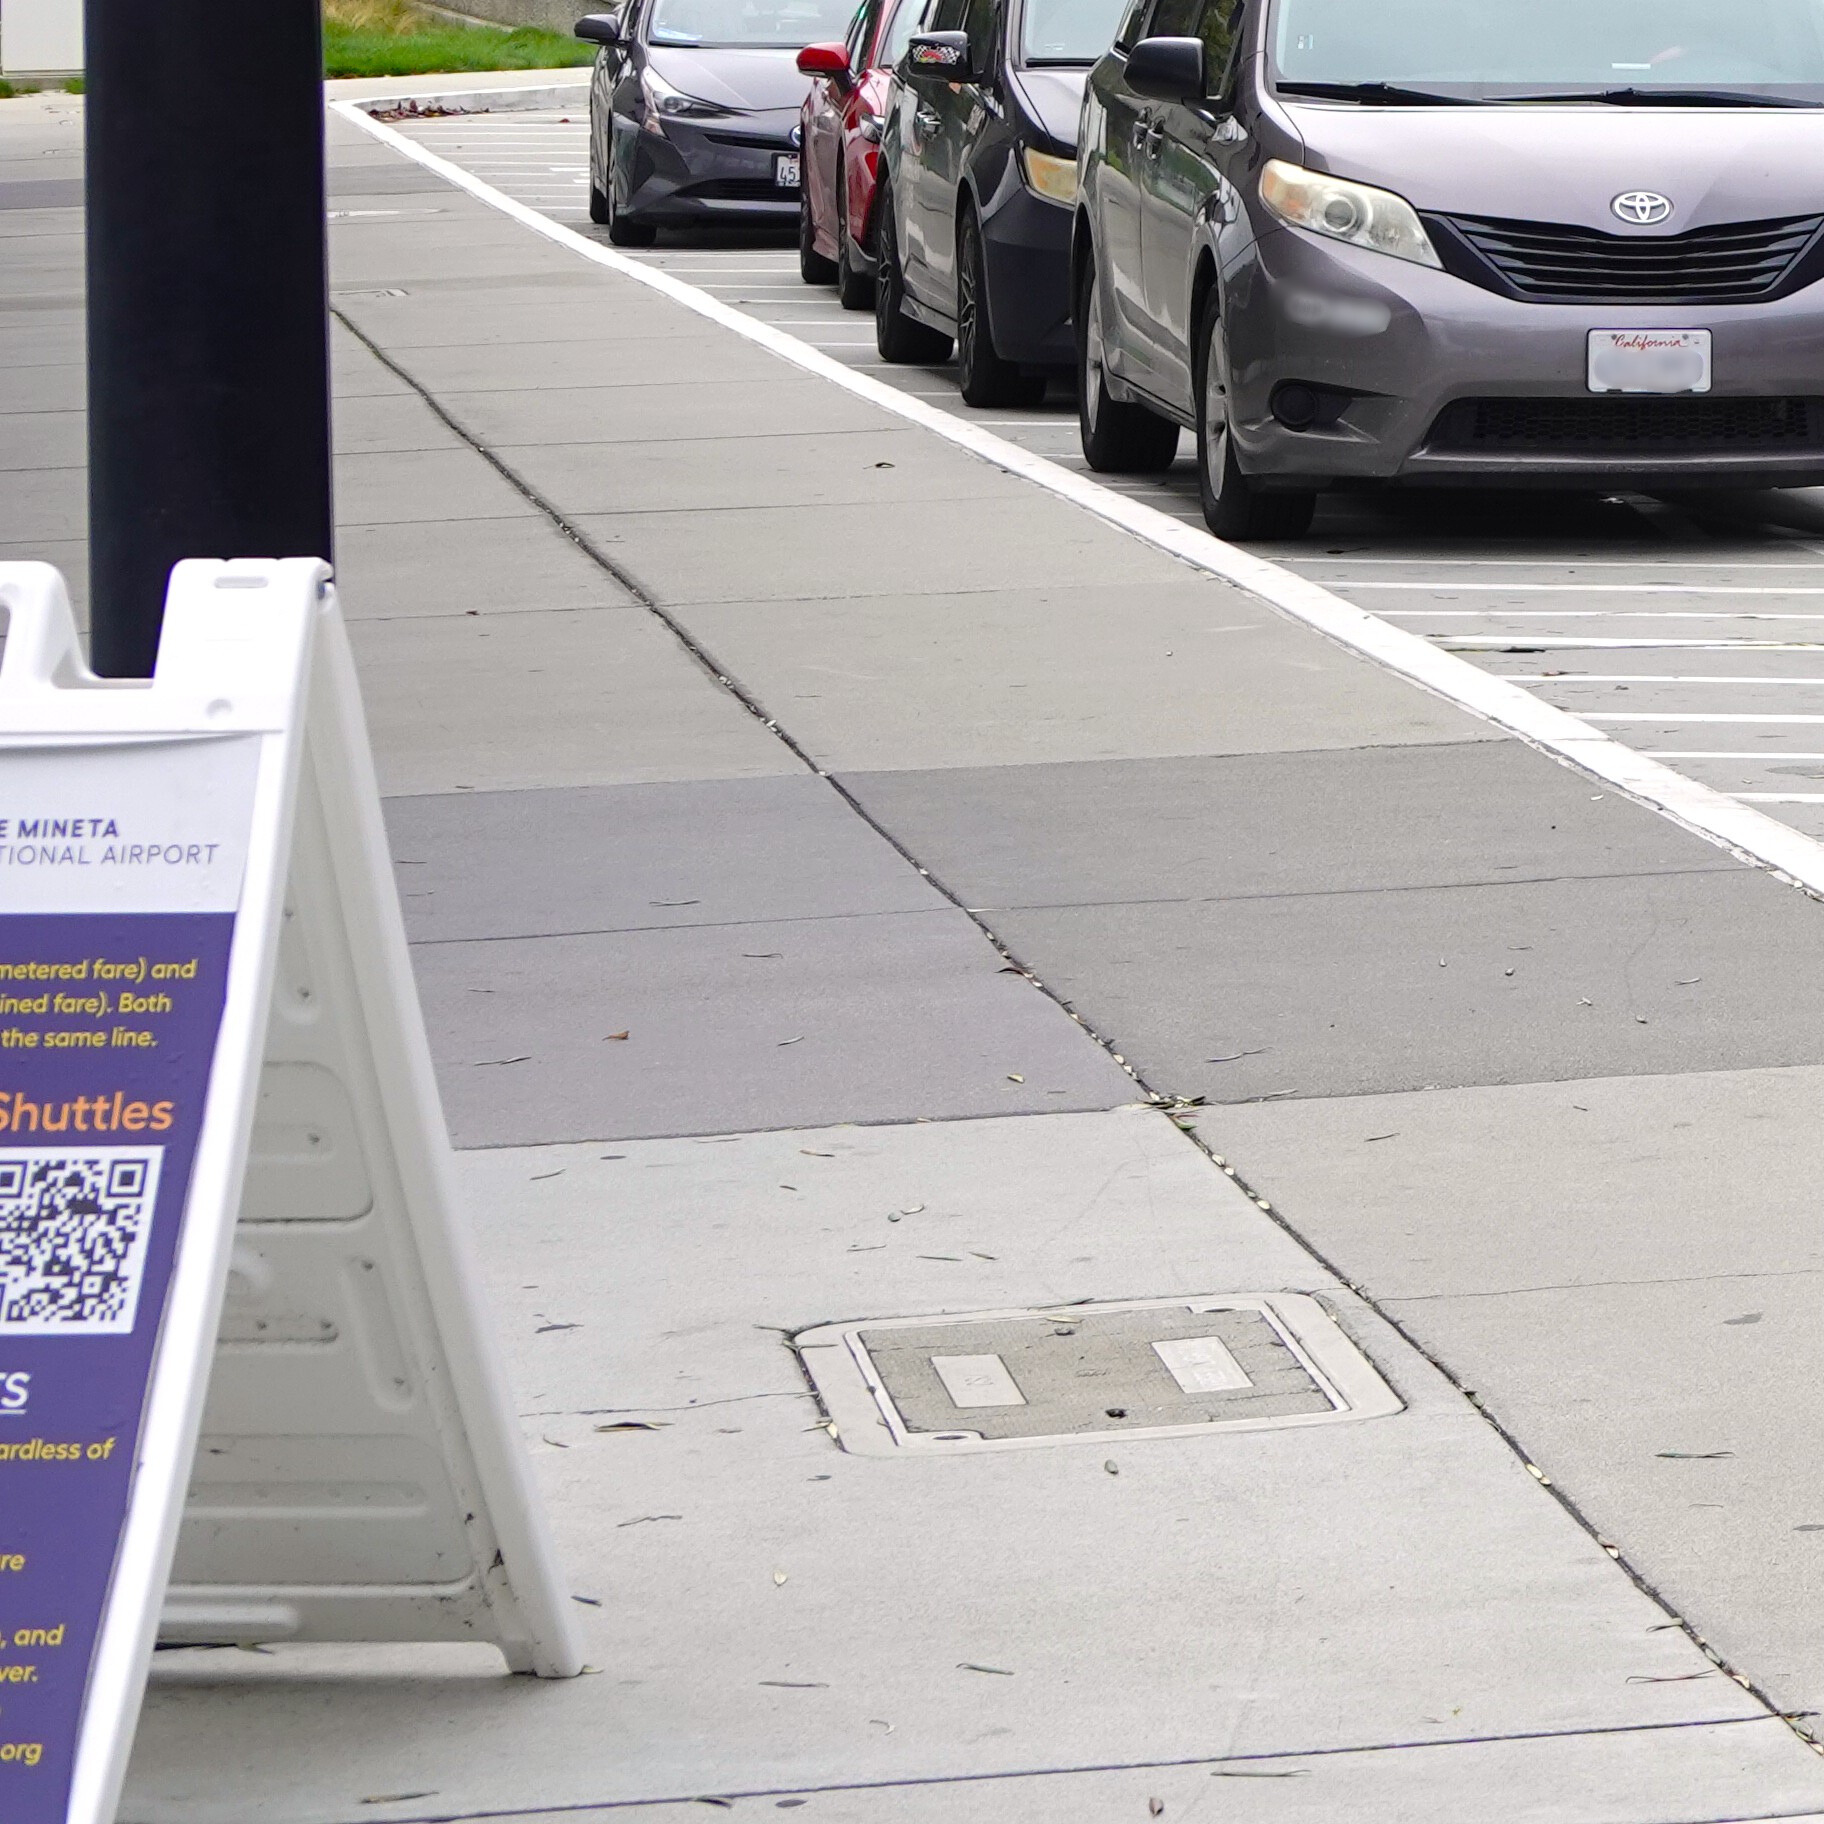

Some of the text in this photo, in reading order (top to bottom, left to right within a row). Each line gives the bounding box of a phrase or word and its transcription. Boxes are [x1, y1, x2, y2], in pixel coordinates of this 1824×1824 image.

[1615, 334, 1688, 350] California
[17, 819, 119, 838] MINETA
[101, 844, 219, 865] AIRPORT
[93, 957, 147, 983] fare)
[151, 958, 198, 979] and
[53, 991, 113, 1017] fare).
[118, 992, 172, 1013] Both
[2, 1027, 158, 1047] the same line.
[0, 1091, 175, 1132] Shuttles
[87, 1436, 116, 1460] of
[14, 1624, 65, 1646] and
